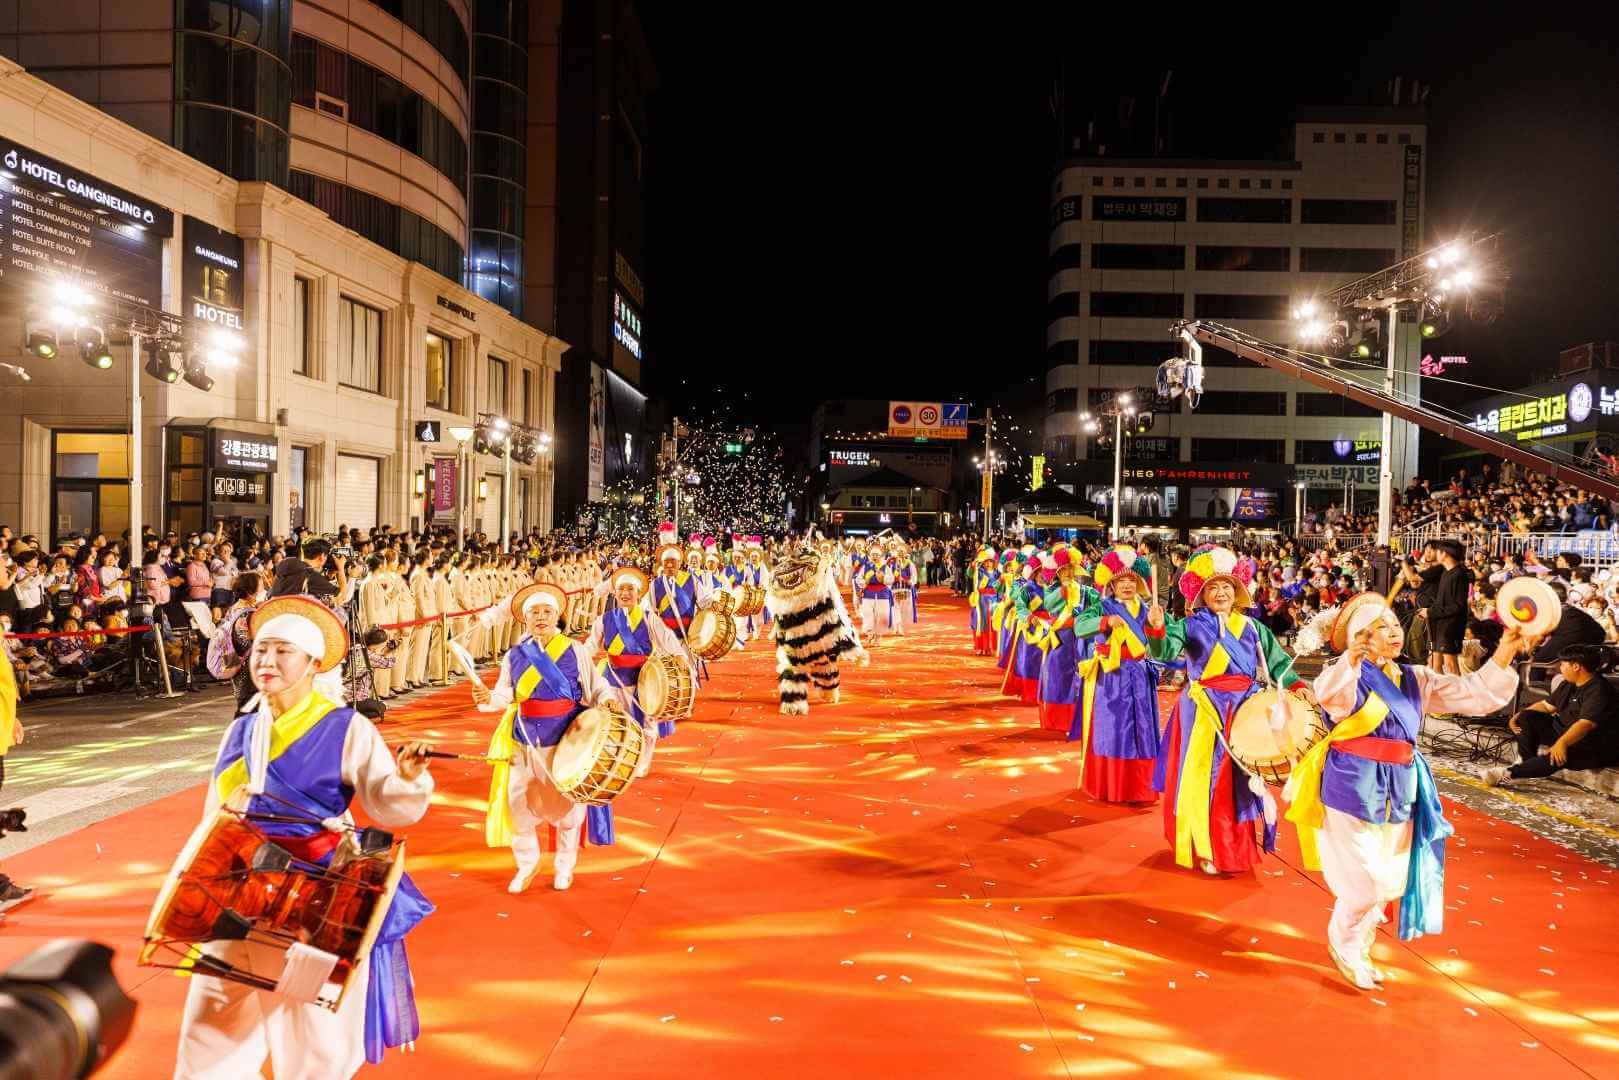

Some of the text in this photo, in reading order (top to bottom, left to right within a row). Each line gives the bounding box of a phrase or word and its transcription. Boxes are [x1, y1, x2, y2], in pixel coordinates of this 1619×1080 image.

[12, 185, 35, 199] HOTEL
[21, 158, 142, 218] HOTEL GANGNEUNG
[12, 199, 90, 233] HOTEL STANDARD ROOM
[12, 213, 92, 248] HOTEL COMMUNITY ZONE
[12, 228, 76, 256] HOTEL SUITE ROOM
[12, 243, 50, 261] BEAN POLE
[12, 257, 35, 270] HOTEL
[194, 245, 238, 269] GANGNEUNG
[193, 302, 243, 330] HOTEL
[1440, 356, 1468, 364] MOTEL
[922, 411, 934, 421] 30
[829, 451, 870, 460] TRUGEN
[442, 460, 452, 507] WELCOME
[1122, 469, 1250, 480] SIEG FAHRENHEIT
